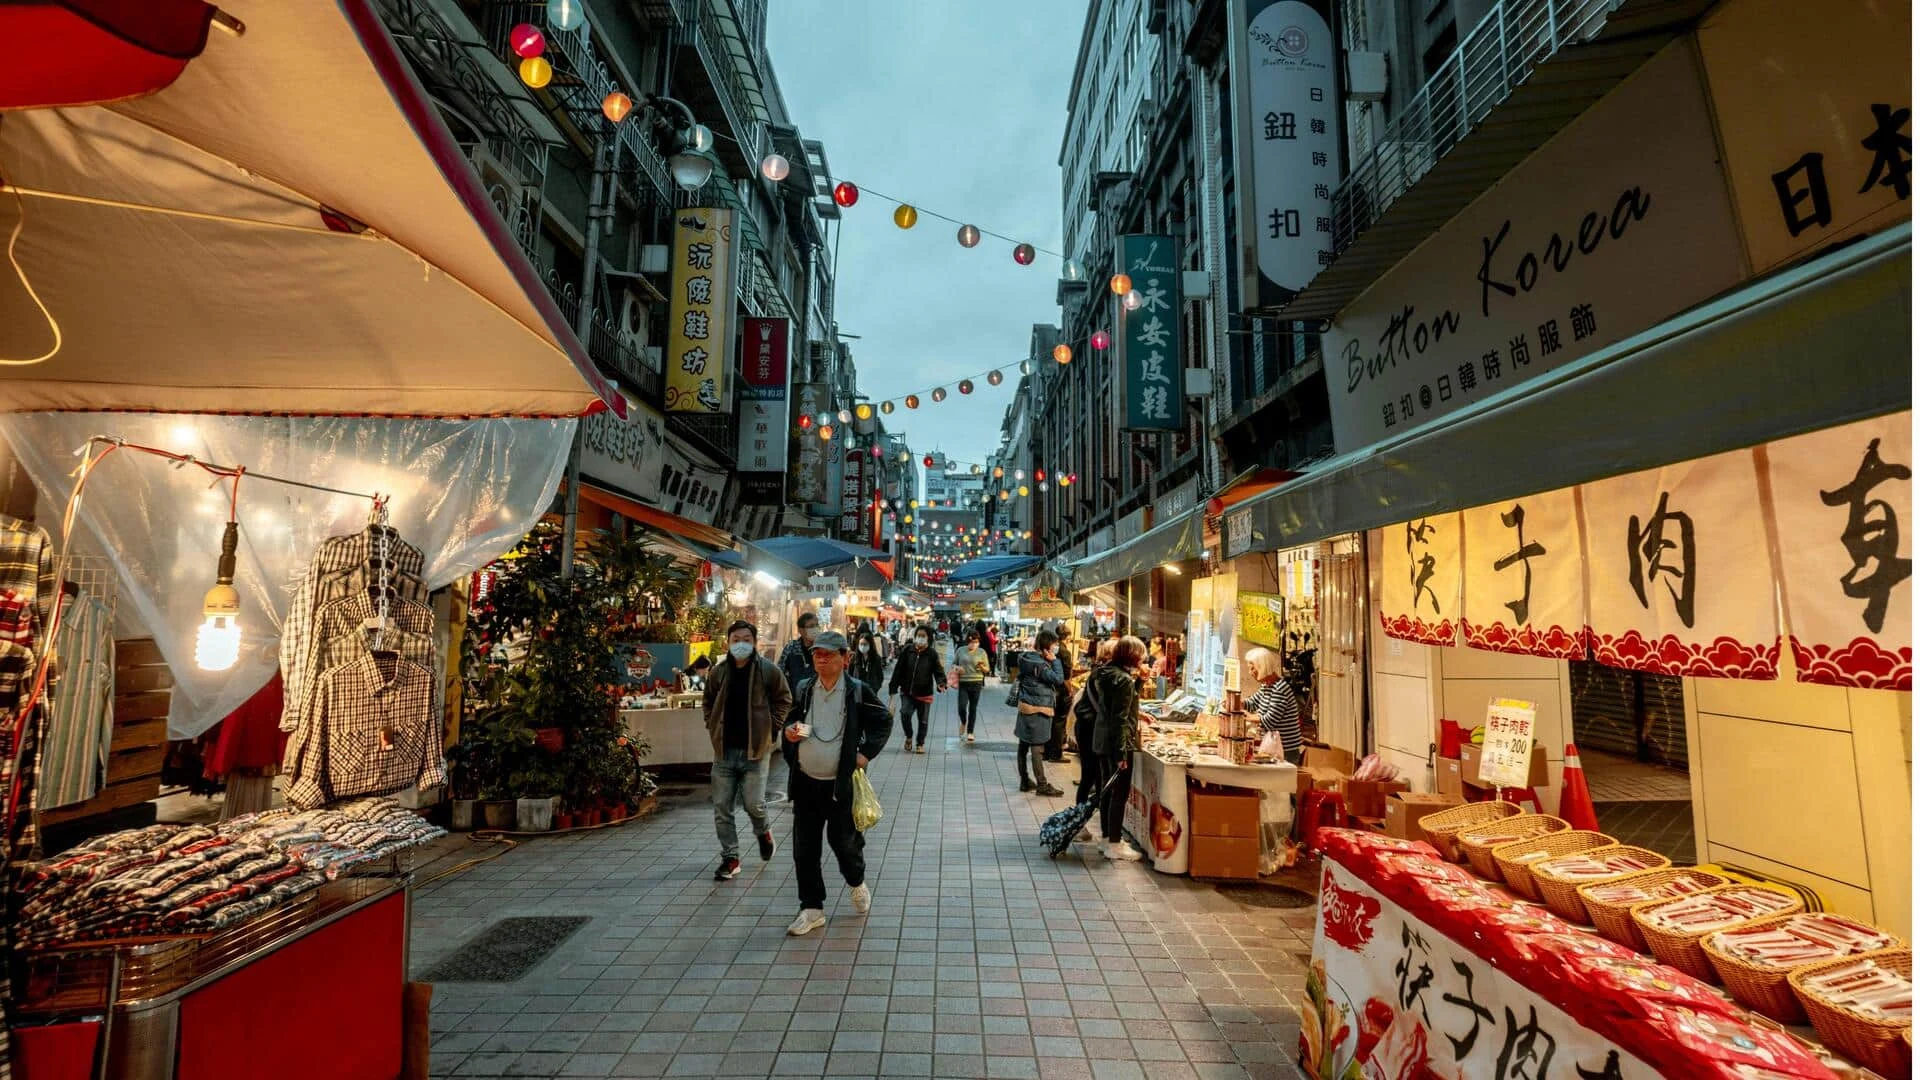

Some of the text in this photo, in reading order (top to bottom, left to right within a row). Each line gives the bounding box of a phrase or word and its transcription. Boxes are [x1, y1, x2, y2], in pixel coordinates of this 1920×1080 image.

[1264, 111, 1300, 239] 鈕扣
[1310, 87, 1333, 264] 日韓時尚服飾
[1771, 104, 1912, 237] 日本
[681, 242, 712, 376] 沅陵鞋坊
[1136, 279, 1172, 420] 永安皮鞋
[1341, 185, 1650, 394] Button Korea
[1490, 716, 1529, 737] 筷子肉乾
